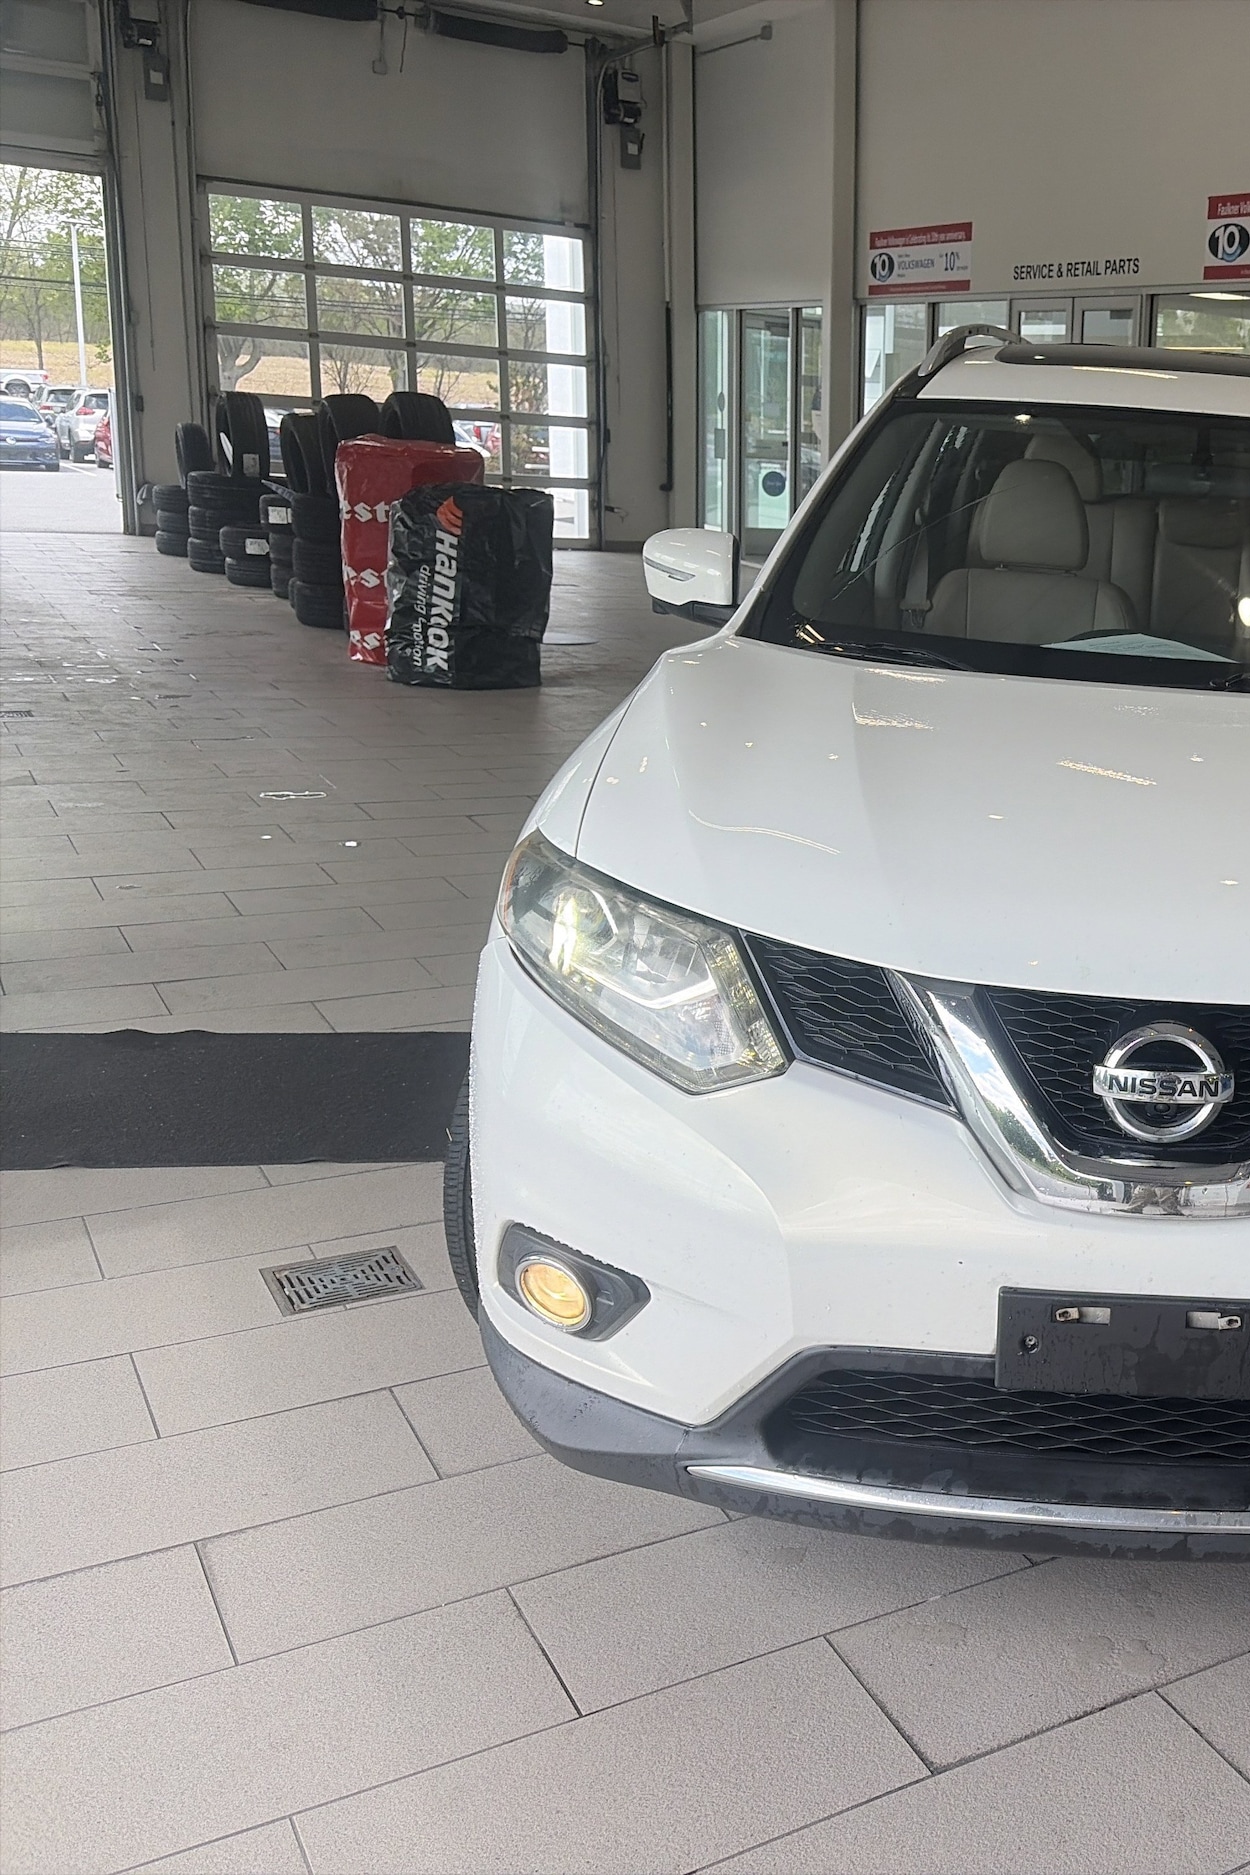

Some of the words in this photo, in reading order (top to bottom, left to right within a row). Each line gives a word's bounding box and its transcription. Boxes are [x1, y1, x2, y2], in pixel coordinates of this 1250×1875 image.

[897, 258, 935, 270] VOLKSWAGEN
[1013, 263, 1054, 280] SERVICE
[1056, 263, 1063, 278] &
[1066, 261, 1101, 278] RETAIL
[1104, 257, 1140, 276] PARTS
[414, 564, 431, 615] driving
[1108, 1075, 1220, 1098] NISSAN
